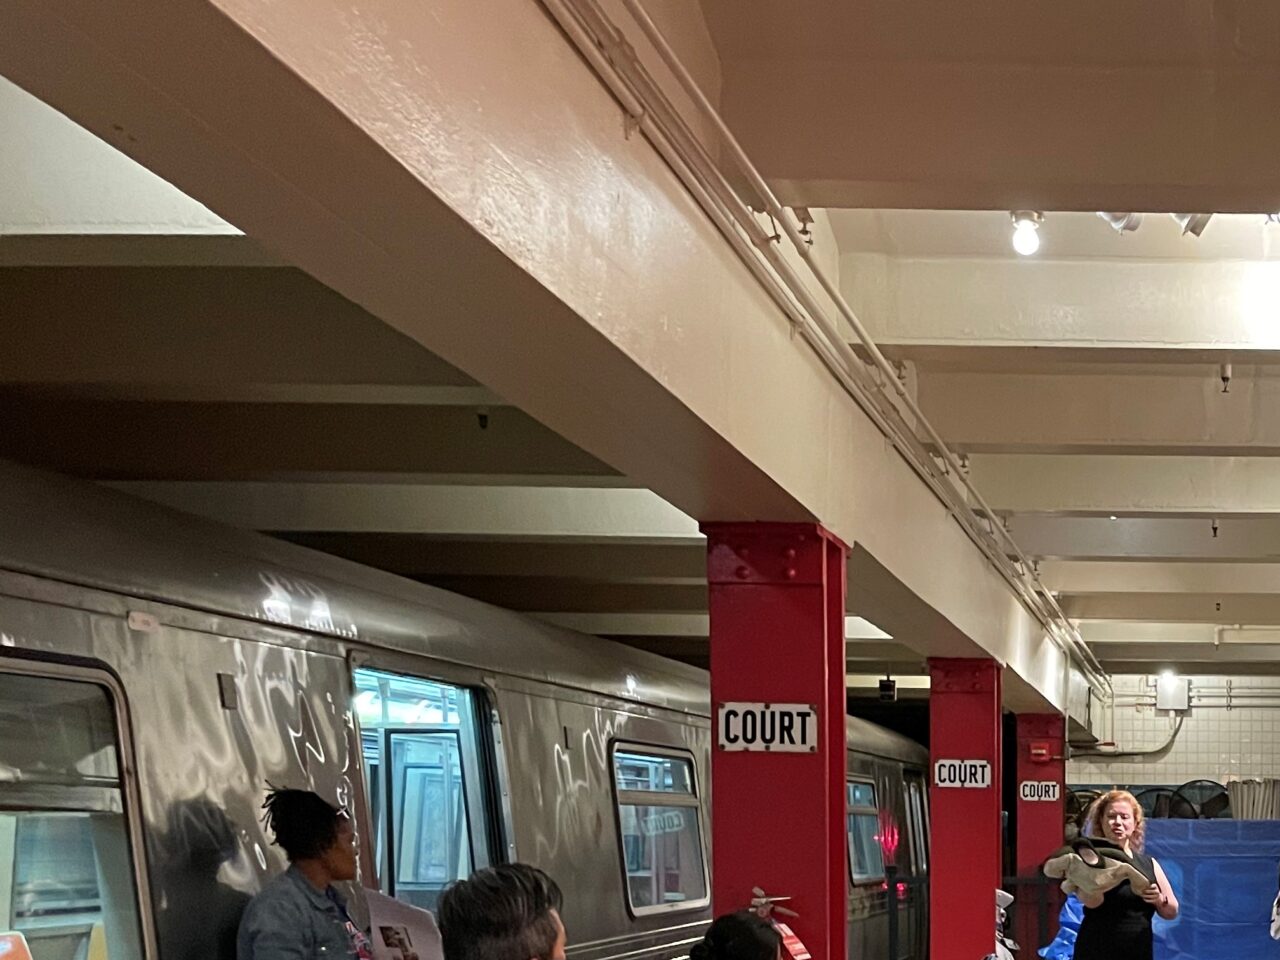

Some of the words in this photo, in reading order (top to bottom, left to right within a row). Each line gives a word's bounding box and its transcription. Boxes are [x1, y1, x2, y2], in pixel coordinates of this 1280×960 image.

[724, 709, 811, 746] COURT
[937, 763, 988, 784] COURT
[1021, 783, 1057, 799] COURT
